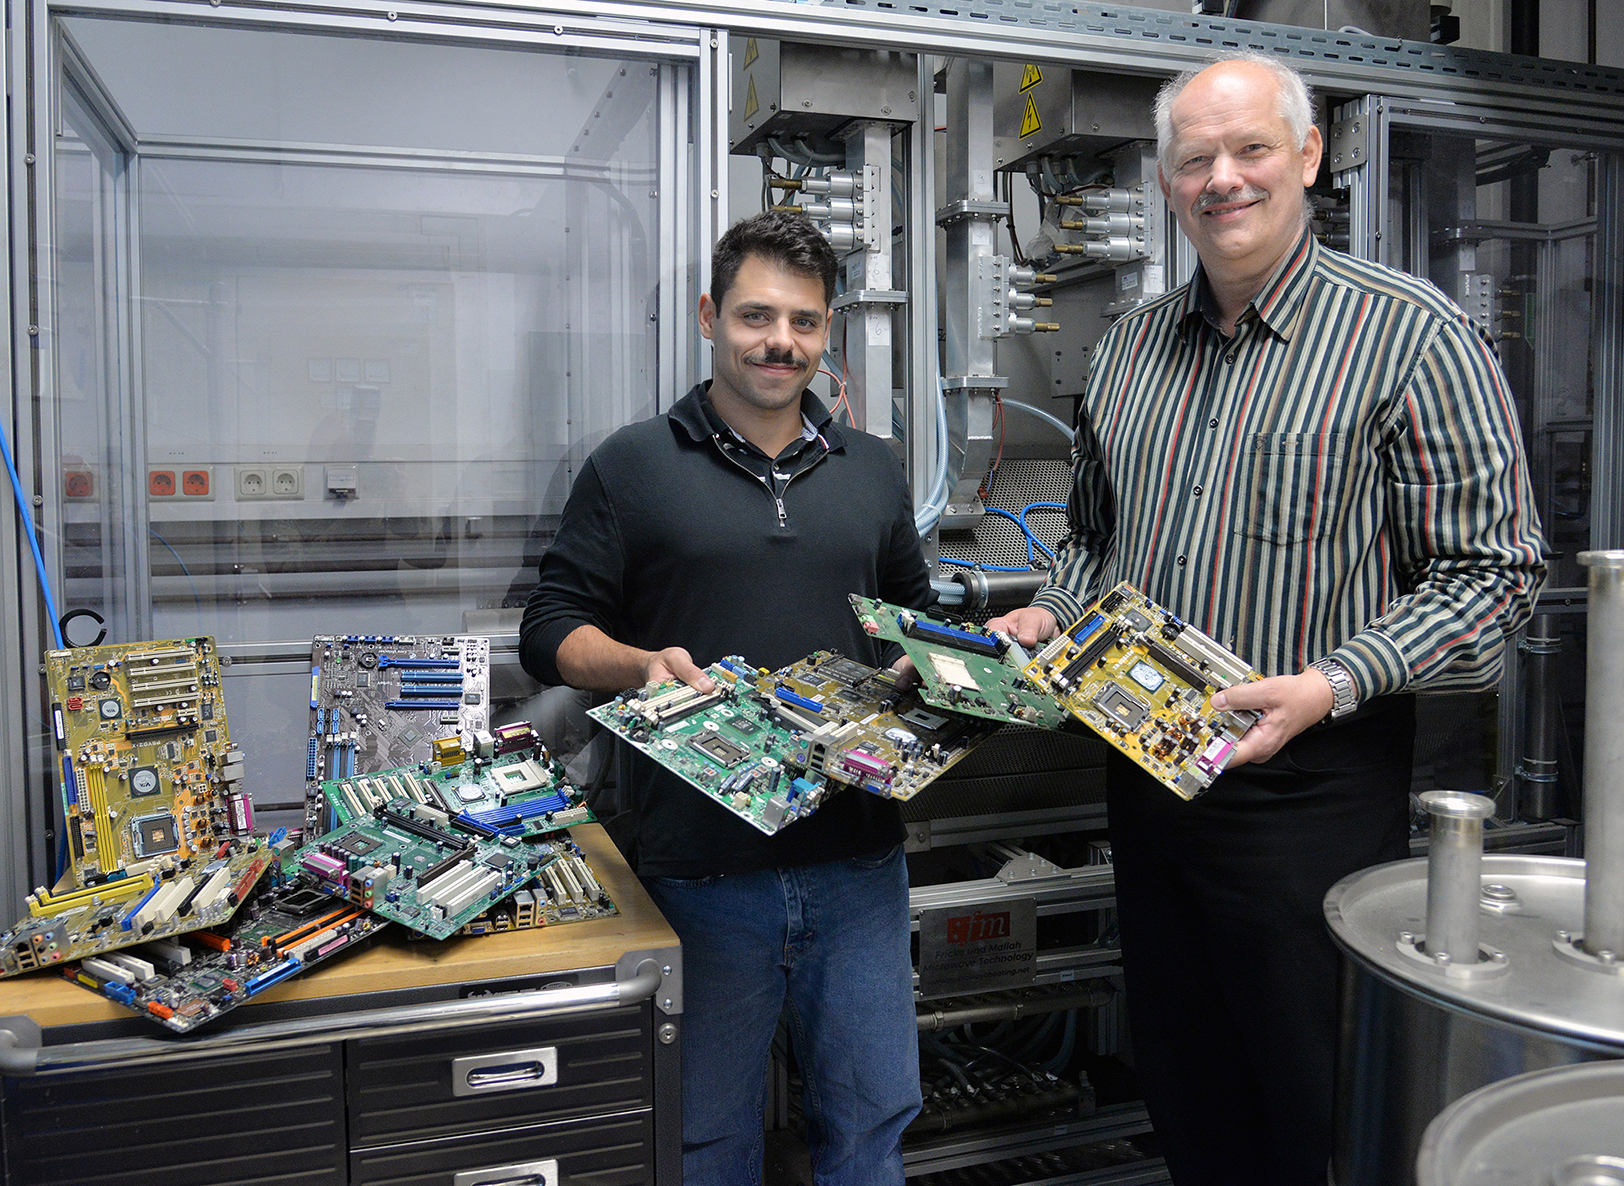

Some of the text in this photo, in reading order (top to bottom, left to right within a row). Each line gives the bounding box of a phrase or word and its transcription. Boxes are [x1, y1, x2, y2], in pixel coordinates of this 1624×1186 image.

[875, 321, 882, 336] 6
[967, 944, 986, 955] und
[988, 941, 1022, 953] Mallah
[978, 951, 1034, 965] Technology
